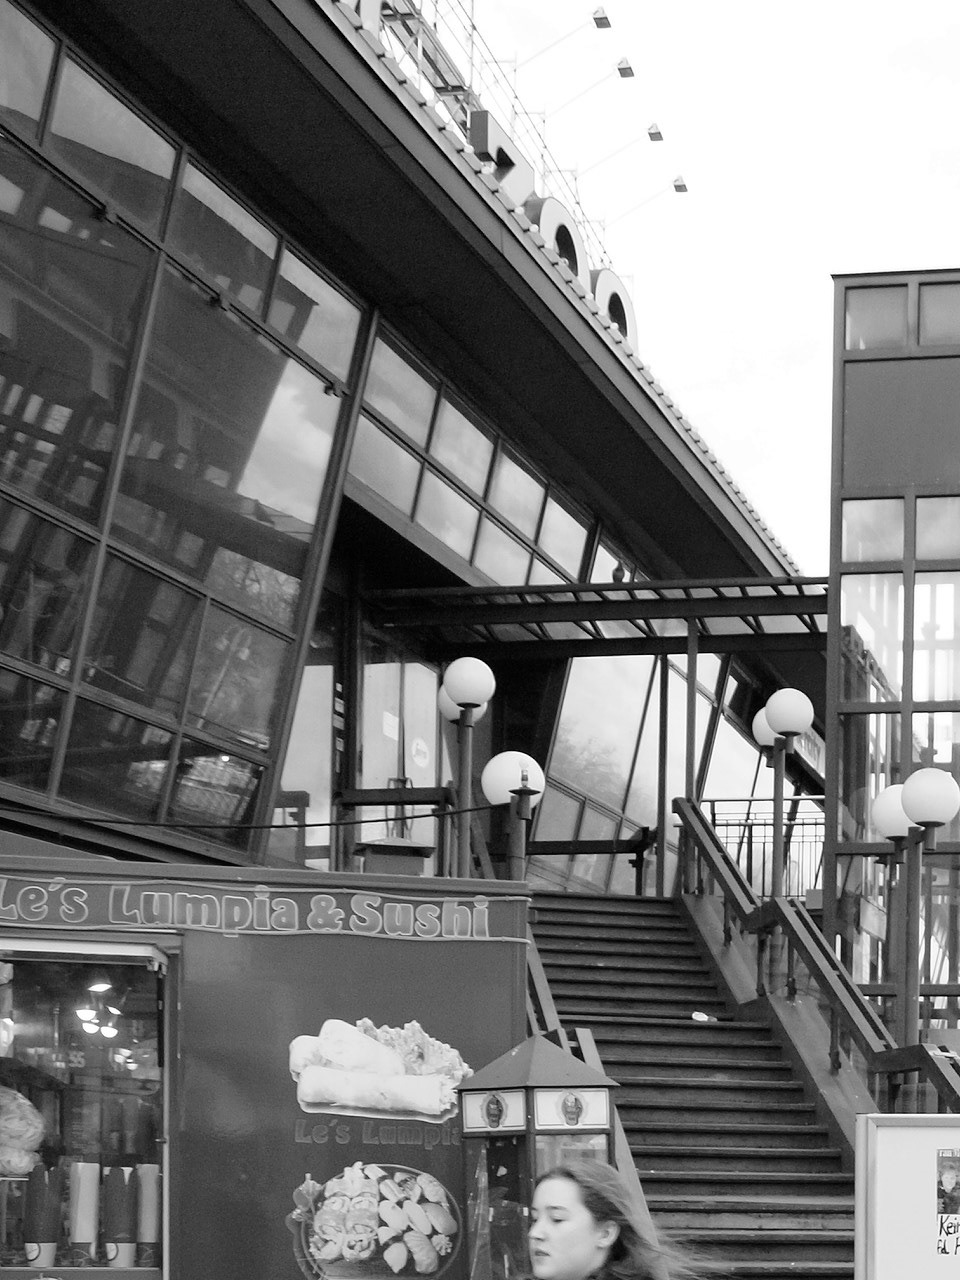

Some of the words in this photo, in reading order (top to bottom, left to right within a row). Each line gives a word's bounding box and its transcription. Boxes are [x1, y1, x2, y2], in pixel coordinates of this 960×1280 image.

[0, 877, 88, 923] Le's
[109, 885, 299, 938] Lumpia
[307, 894, 345, 931] &
[349, 893, 489, 938] Sushi
